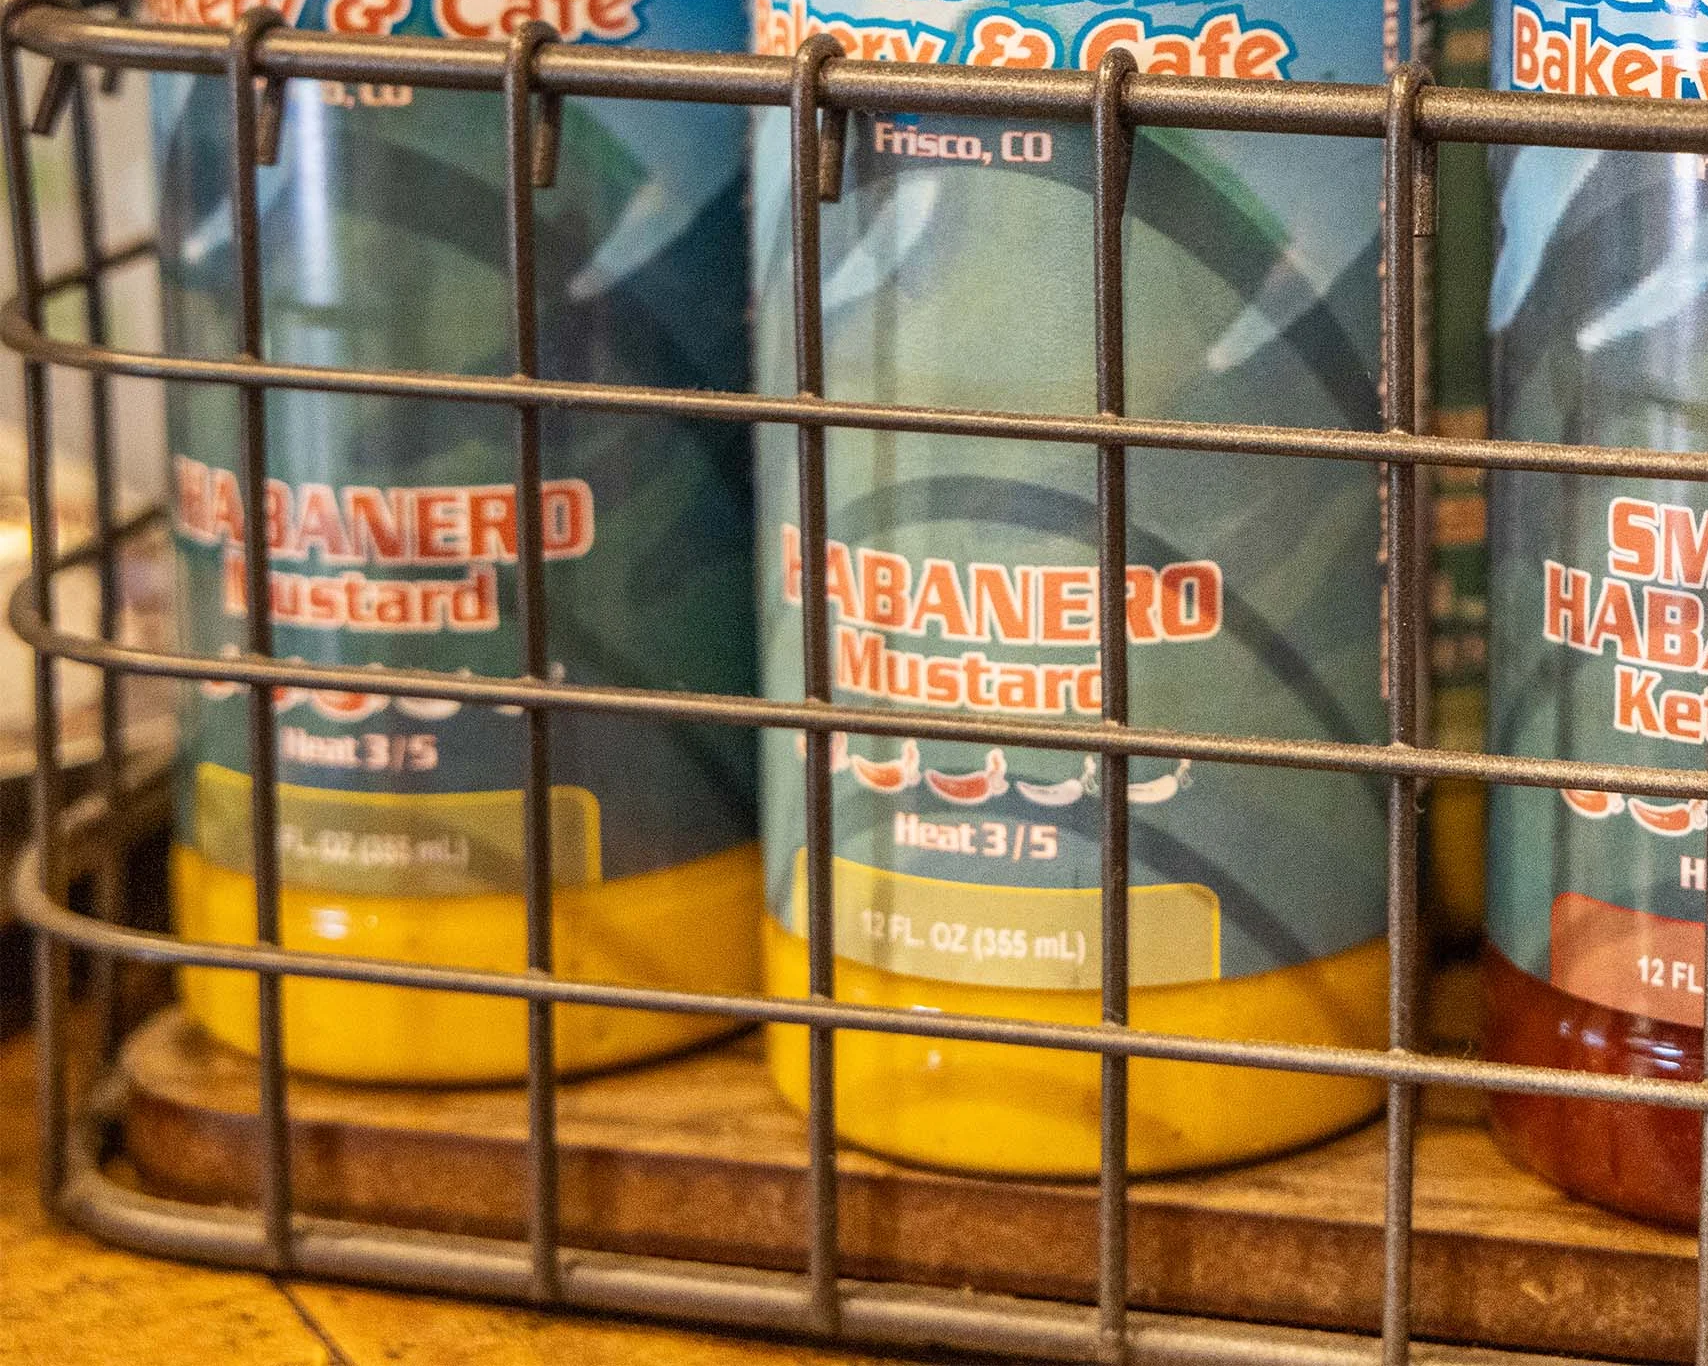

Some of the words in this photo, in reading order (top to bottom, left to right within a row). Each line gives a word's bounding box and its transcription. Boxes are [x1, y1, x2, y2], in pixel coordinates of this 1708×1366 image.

[968, 15, 1055, 70] &
[1079, 12, 1290, 80] Cafe
[873, 121, 992, 165] Frisco,
[1001, 131, 1053, 163] CO
[175, 455, 594, 566] HABANERO
[894, 811, 976, 855] Heat
[860, 908, 885, 938] 12
[887, 912, 925, 947] FL.
[929, 920, 969, 953] OZ
[973, 927, 1029, 962] (355
[1033, 930, 1087, 966] mL)
[1637, 954, 1664, 986] 12
[1671, 960, 1706, 995] FL
